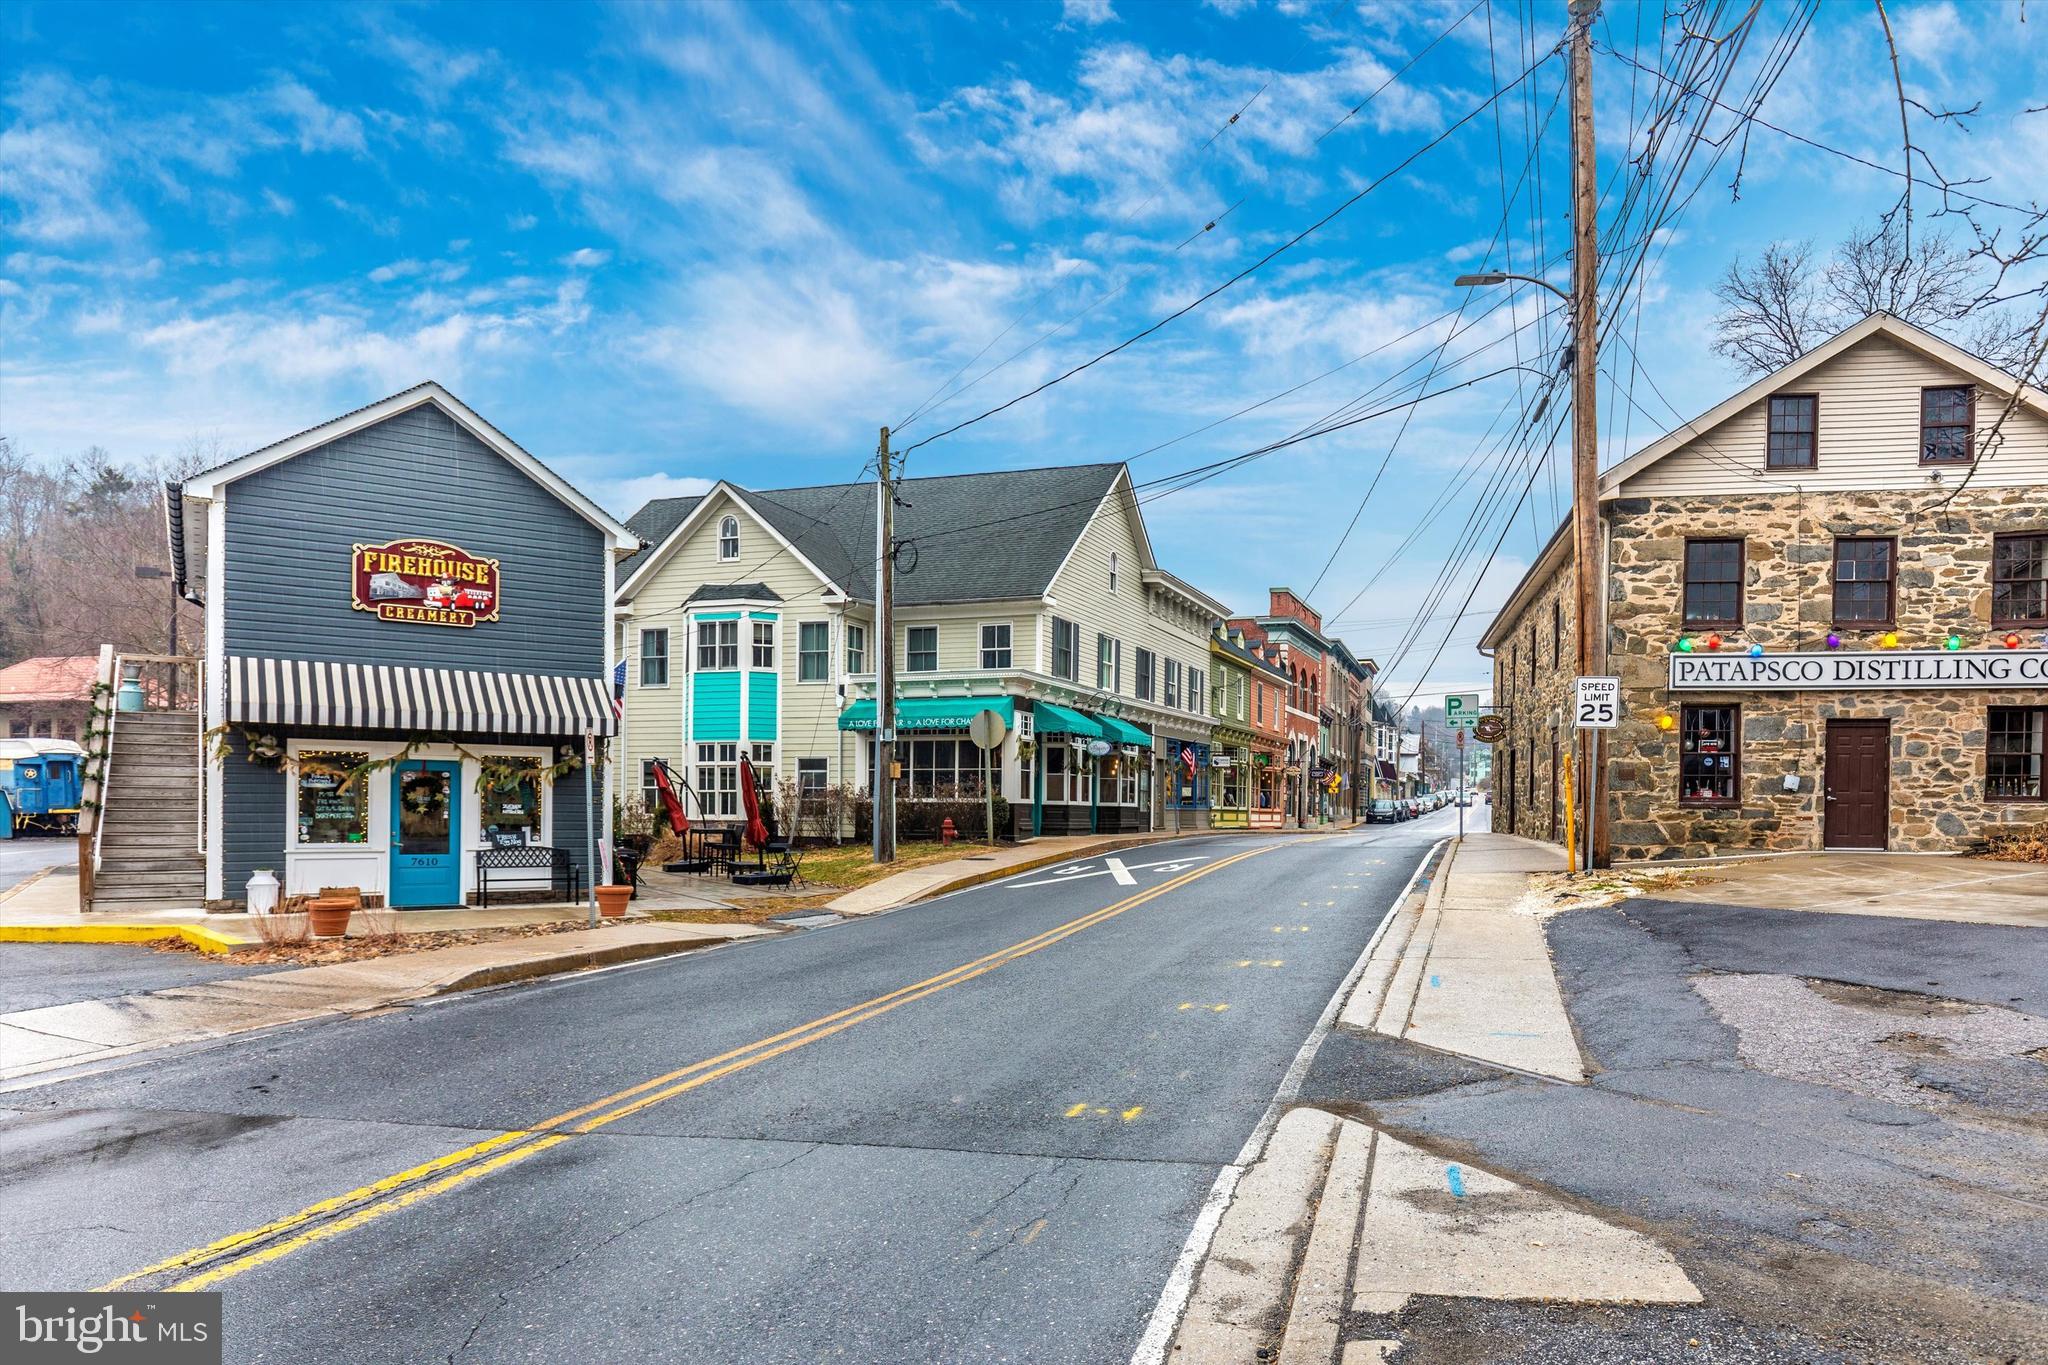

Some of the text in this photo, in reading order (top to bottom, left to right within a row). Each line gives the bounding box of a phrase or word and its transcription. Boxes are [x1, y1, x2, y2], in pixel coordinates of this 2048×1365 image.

[363, 551, 490, 585] FIREHOUSE
[385, 606, 467, 624] CREAMERY
[1679, 660, 1824, 682] PATAPSCO
[1832, 658, 2012, 682] DISTILLING
[1581, 683, 1615, 691] SPEED
[1584, 693, 1610, 702] LIMIT
[1580, 704, 1613, 722] 25
[848, 720, 855, 728] A
[855, 719, 873, 728] LOVE
[922, 718, 940, 726] LOVE
[940, 717, 955, 726] FOR
[411, 858, 438, 866] 7610
